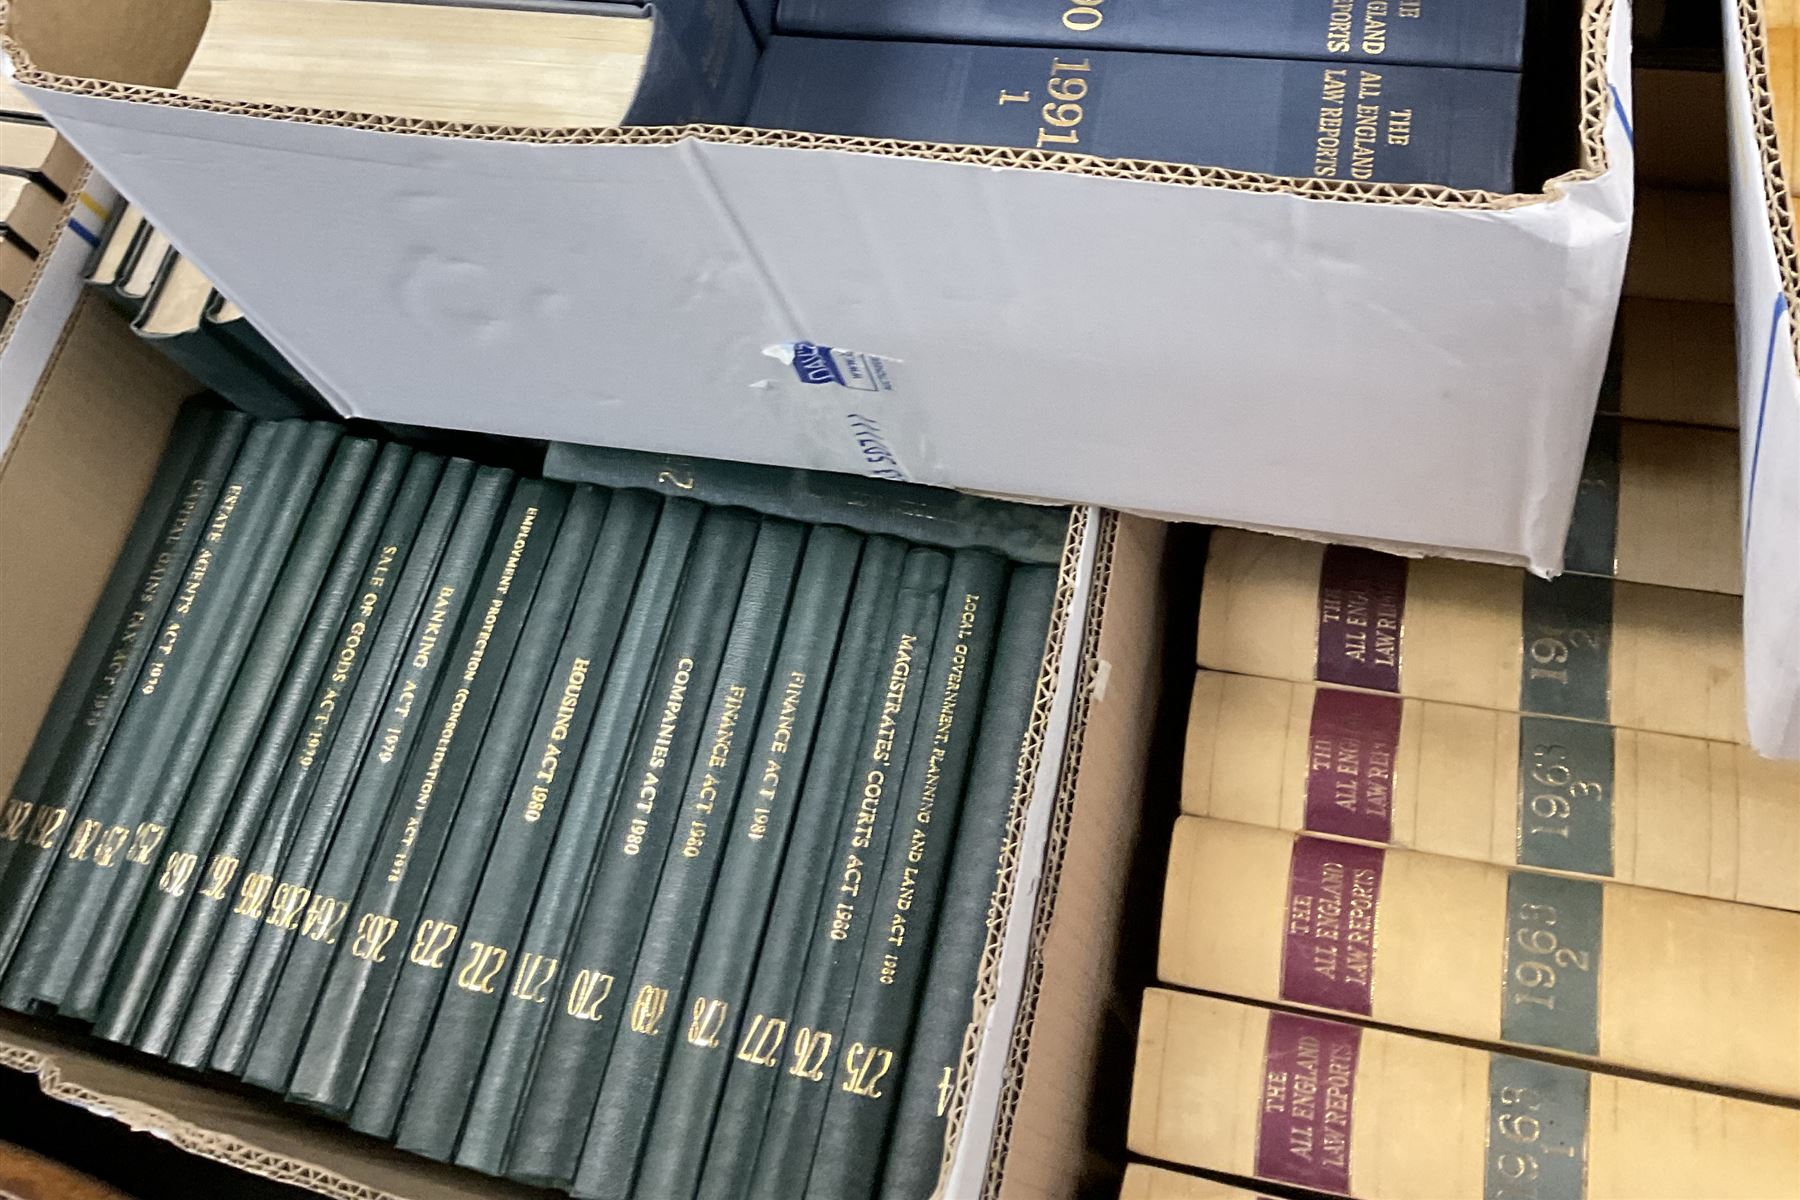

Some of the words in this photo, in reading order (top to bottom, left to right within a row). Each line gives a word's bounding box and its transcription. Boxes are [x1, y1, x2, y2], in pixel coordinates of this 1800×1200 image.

[999, 89, 1030, 105] 1
[1036, 57, 1092, 147] 1991
[1321, 69, 1348, 104] LAW
[1358, 70, 1382, 100] ALL
[1314, 107, 1344, 178] REPORTS
[1351, 104, 1381, 181] ENGLAND
[1387, 108, 1413, 147] THE
[167, 478, 209, 544] CAPITAL
[207, 483, 243, 544] ESTATE
[369, 545, 398, 588] SALE
[497, 506, 539, 595] EMPLOYMENT
[141, 551, 172, 603] GAINS
[176, 548, 213, 616] AGENTS
[122, 610, 146, 642] TAX
[360, 592, 378, 617] OF
[958, 594, 980, 639] LOCAL
[159, 621, 181, 656] ACT
[413, 585, 455, 669] BANKING
[463, 598, 504, 682] PROTECTION
[1344, 631, 1367, 662] ALL
[1375, 630, 1396, 667] LAW
[103, 648, 127, 685] ACT
[332, 621, 366, 683] GOODS
[1530, 630, 1569, 685] 19
[142, 661, 165, 696] 1979
[395, 680, 417, 718] ACT
[551, 657, 591, 741] HOUSING
[873, 633, 918, 767] MAGISTRATES'
[934, 644, 968, 745] GOVERNMENT,
[315, 687, 339, 726] ACT
[649, 657, 694, 768] COMPANIES
[708, 682, 747, 768] FINANCE
[771, 671, 807, 754] FINANCE
[299, 732, 322, 768] 1979
[378, 727, 402, 764] 1979
[414, 687, 470, 811] (CONSOLIDATION)
[536, 743, 562, 784] ACT
[636, 772, 660, 814] ACT
[695, 773, 720, 815] ACT
[759, 759, 782, 801] ACT
[916, 747, 946, 824] PLANNING
[1335, 779, 1357, 812] ALL
[1366, 781, 1387, 817] LAW
[1530, 743, 1572, 839] 1963
[1569, 780, 1602, 801] 3
[524, 785, 549, 822] 1980
[748, 807, 771, 840] 1981
[851, 770, 885, 848] COURTS
[400, 816, 420, 848] ACT
[623, 818, 648, 856] 1980
[682, 820, 708, 858] 1980
[908, 828, 926, 863] AND
[841, 854, 865, 898] ACT
[897, 867, 919, 911] LAND
[266, 882, 311, 932] 265
[300, 894, 348, 946] 264
[830, 903, 854, 941] 1980
[1291, 895, 1313, 935] THE
[1316, 862, 1345, 941] ENGLAND
[1348, 868, 1376, 947] REPORTS
[352, 913, 399, 963] 263
[410, 918, 458, 970] 273
[888, 914, 907, 947] ACT
[456, 940, 508, 996] 272
[511, 951, 559, 1005] 271
[879, 954, 899, 985] 1980
[1314, 947, 1338, 980] ALL
[1345, 945, 1367, 986] LAW
[1515, 902, 1558, 1010] 1963
[1555, 948, 1590, 972] 2
[566, 968, 614, 1023] 270
[687, 996, 729, 1049] 278
[737, 1013, 787, 1068] 277
[788, 1026, 832, 1083] 276
[841, 1041, 893, 1100] 275
[1266, 1071, 1288, 1113] THE
[1292, 1036, 1321, 1122] ENGLAND
[1324, 1045, 1353, 1127] REPORTS
[1290, 1127, 1314, 1162] ALL
[1323, 1128, 1346, 1169] LAW
[1540, 1145, 1575, 1158] 1
